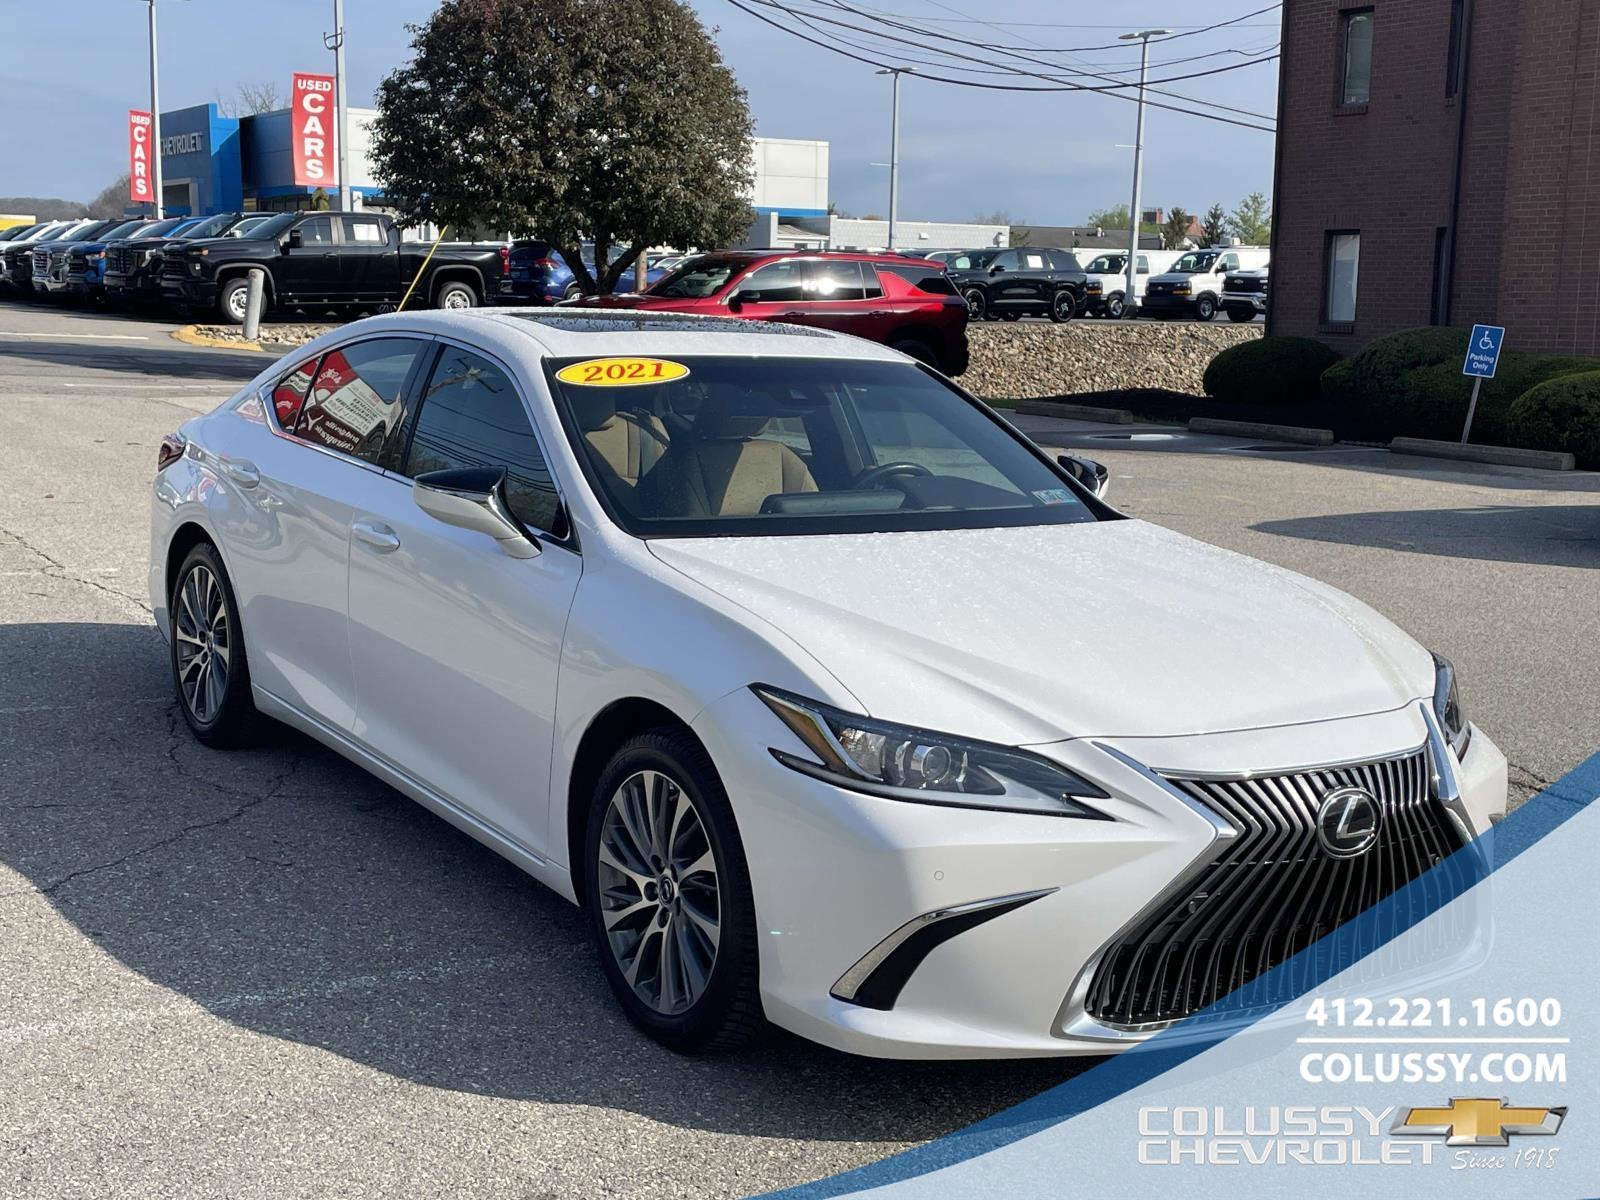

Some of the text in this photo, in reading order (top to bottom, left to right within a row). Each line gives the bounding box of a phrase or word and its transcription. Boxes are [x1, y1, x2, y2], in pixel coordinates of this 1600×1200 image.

[298, 79, 332, 92] USED
[131, 115, 150, 125] USED
[302, 93, 326, 180] CARS
[133, 126, 148, 195] CARS
[1469, 352, 1494, 364] Parking
[584, 362, 665, 382] 2021
[1472, 361, 1488, 371] Only
